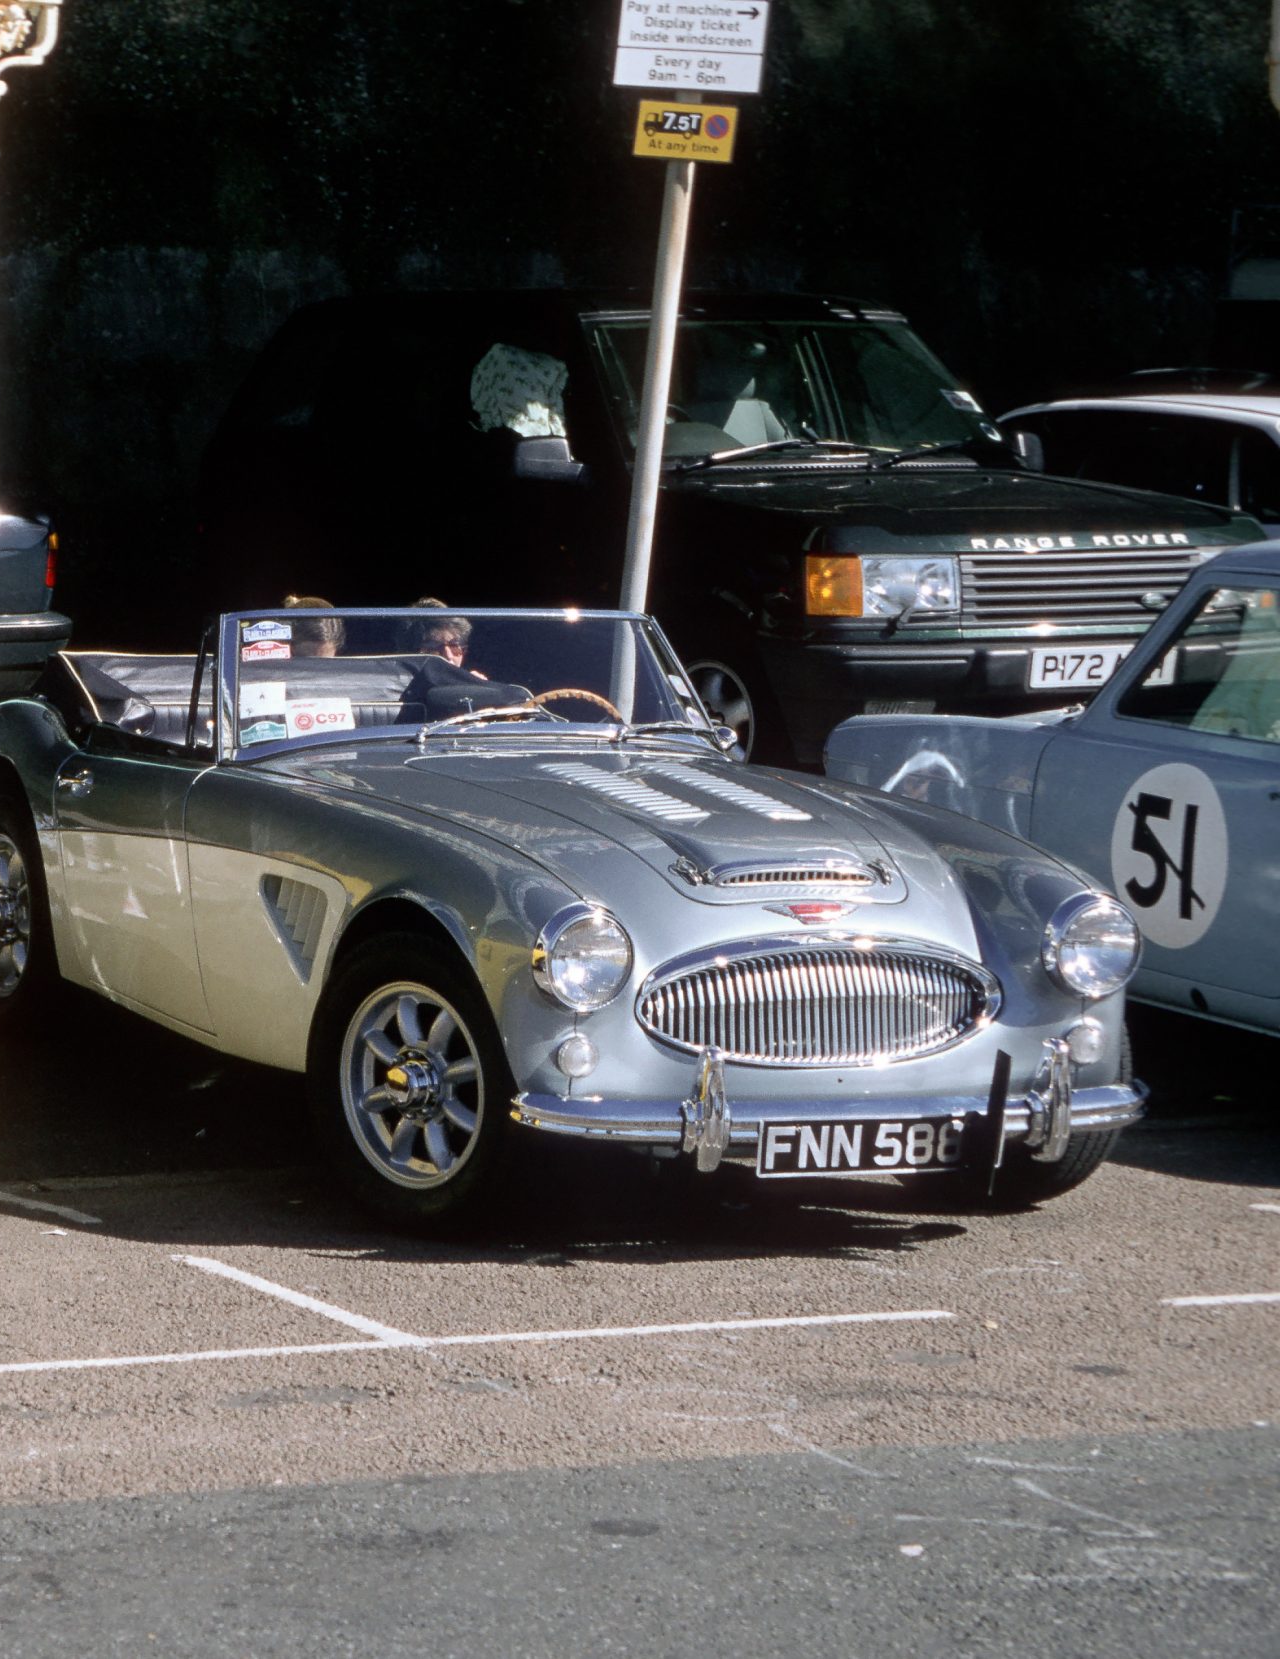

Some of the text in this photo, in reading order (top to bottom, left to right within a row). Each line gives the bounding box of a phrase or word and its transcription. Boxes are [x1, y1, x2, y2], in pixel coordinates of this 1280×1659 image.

[627, 2, 732, 16] Pay at machine
[644, 16, 740, 32] Display ticket
[675, 32, 752, 47] windscreen
[655, 55, 722, 71] Every day
[648, 69, 677, 82] 9am
[697, 71, 726, 84] 6pm
[664, 112, 700, 130] 7.5T
[648, 139, 719, 154] At any time
[971, 533, 1189, 550] RANGE ROVER
[1042, 654, 1104, 681] P172
[316, 713, 346, 724] C97
[1125, 792, 1202, 920] 51
[765, 1123, 863, 1170] FNN
